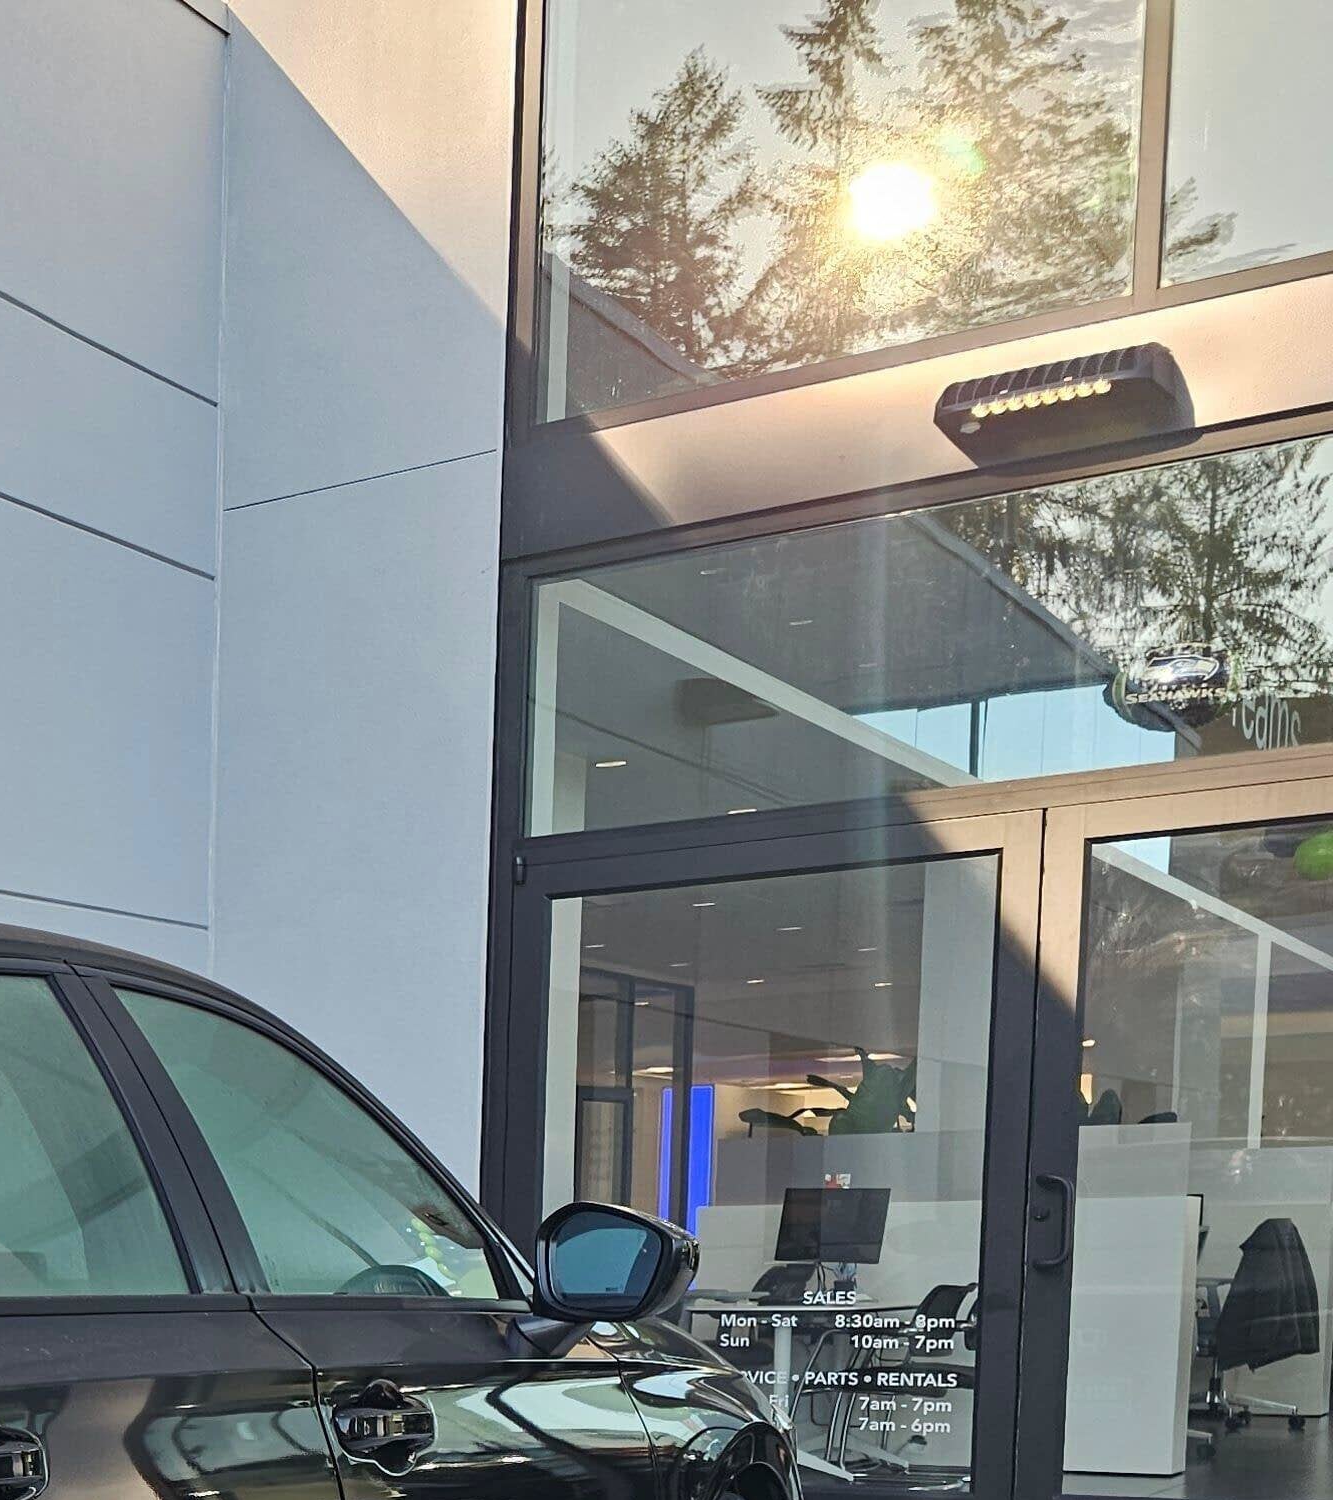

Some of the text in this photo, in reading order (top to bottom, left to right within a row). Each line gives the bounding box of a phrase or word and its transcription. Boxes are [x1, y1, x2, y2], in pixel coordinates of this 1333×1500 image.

[803, 1291, 857, 1305] SALES
[721, 1314, 757, 1328] Mon
[772, 1313, 798, 1328] Sat
[834, 1314, 900, 1329] 8:30am
[916, 1314, 955, 1332] 8pm
[720, 1334, 750, 1347] Sun
[851, 1335, 899, 1349] 10am
[916, 1336, 954, 1352] 7pm
[805, 1371, 859, 1386] PARTS
[877, 1373, 958, 1388] RENTALS
[859, 1397, 896, 1412] 7am
[913, 1398, 952, 1414] 7pm
[858, 1418, 895, 1432] 7am
[912, 1419, 951, 1434] 6pm
